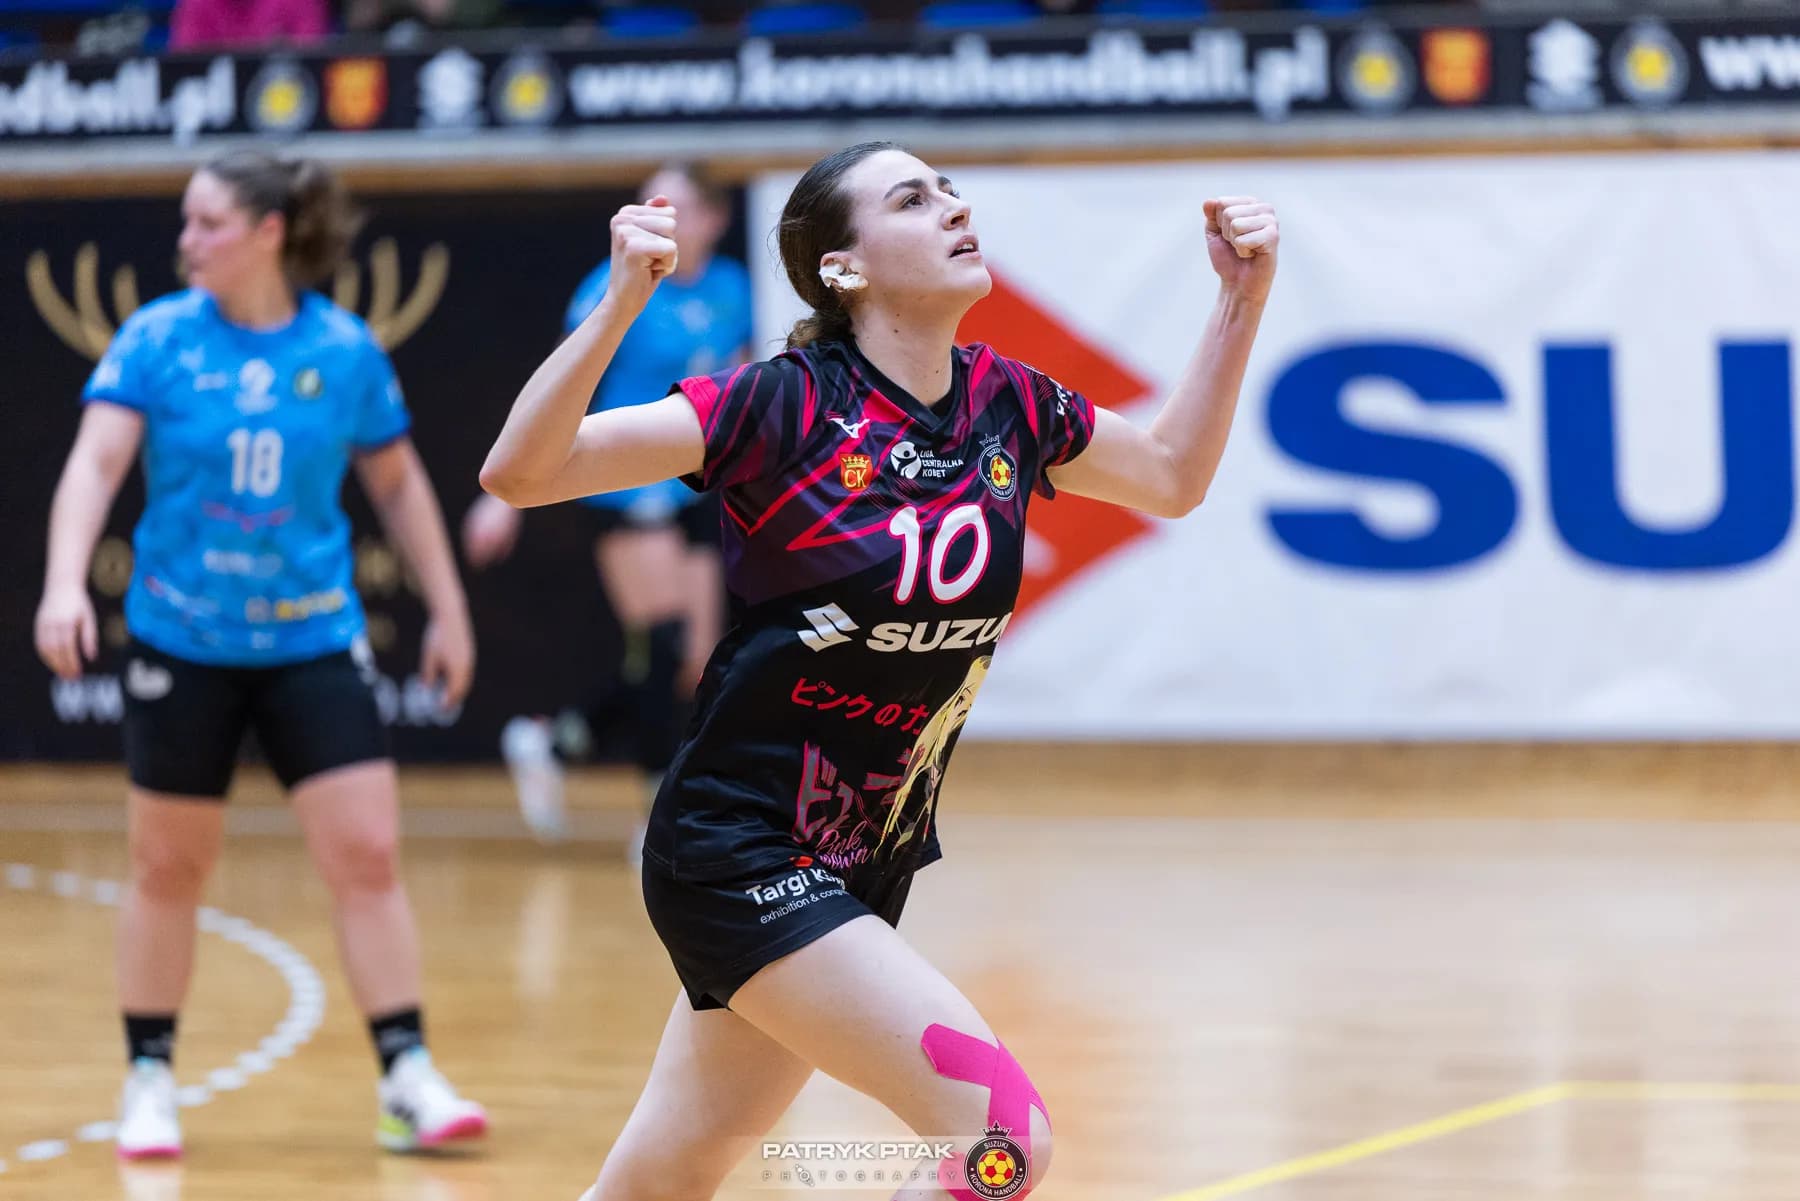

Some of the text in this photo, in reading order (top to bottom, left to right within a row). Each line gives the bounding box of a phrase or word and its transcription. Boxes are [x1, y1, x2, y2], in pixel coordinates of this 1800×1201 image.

[0, 56, 236, 145] dball.pl
[227, 428, 283, 497] 18
[844, 469, 867, 488] CK
[920, 450, 934, 458] LIGA
[1262, 340, 1795, 572] SU
[888, 504, 990, 604] 10
[745, 869, 811, 905] Targi
[760, 897, 810, 924] exhibition
[809, 893, 820, 903] &
